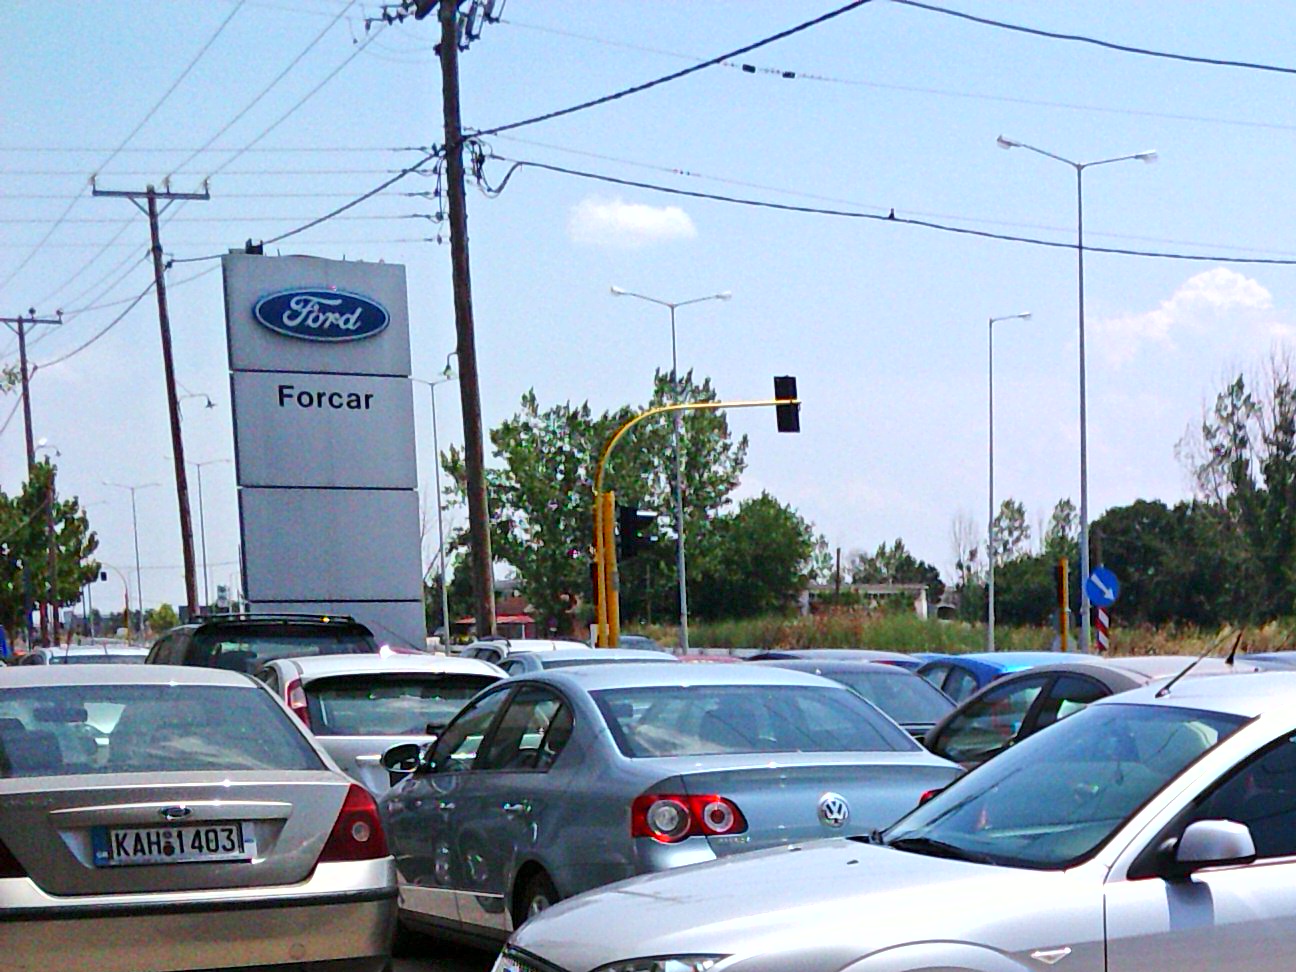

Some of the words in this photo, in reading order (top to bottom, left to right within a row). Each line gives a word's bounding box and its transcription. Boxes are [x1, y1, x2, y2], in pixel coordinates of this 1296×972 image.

[282, 295, 361, 331] Ford
[277, 384, 375, 410] Forcar
[176, 828, 236, 854] 1403
